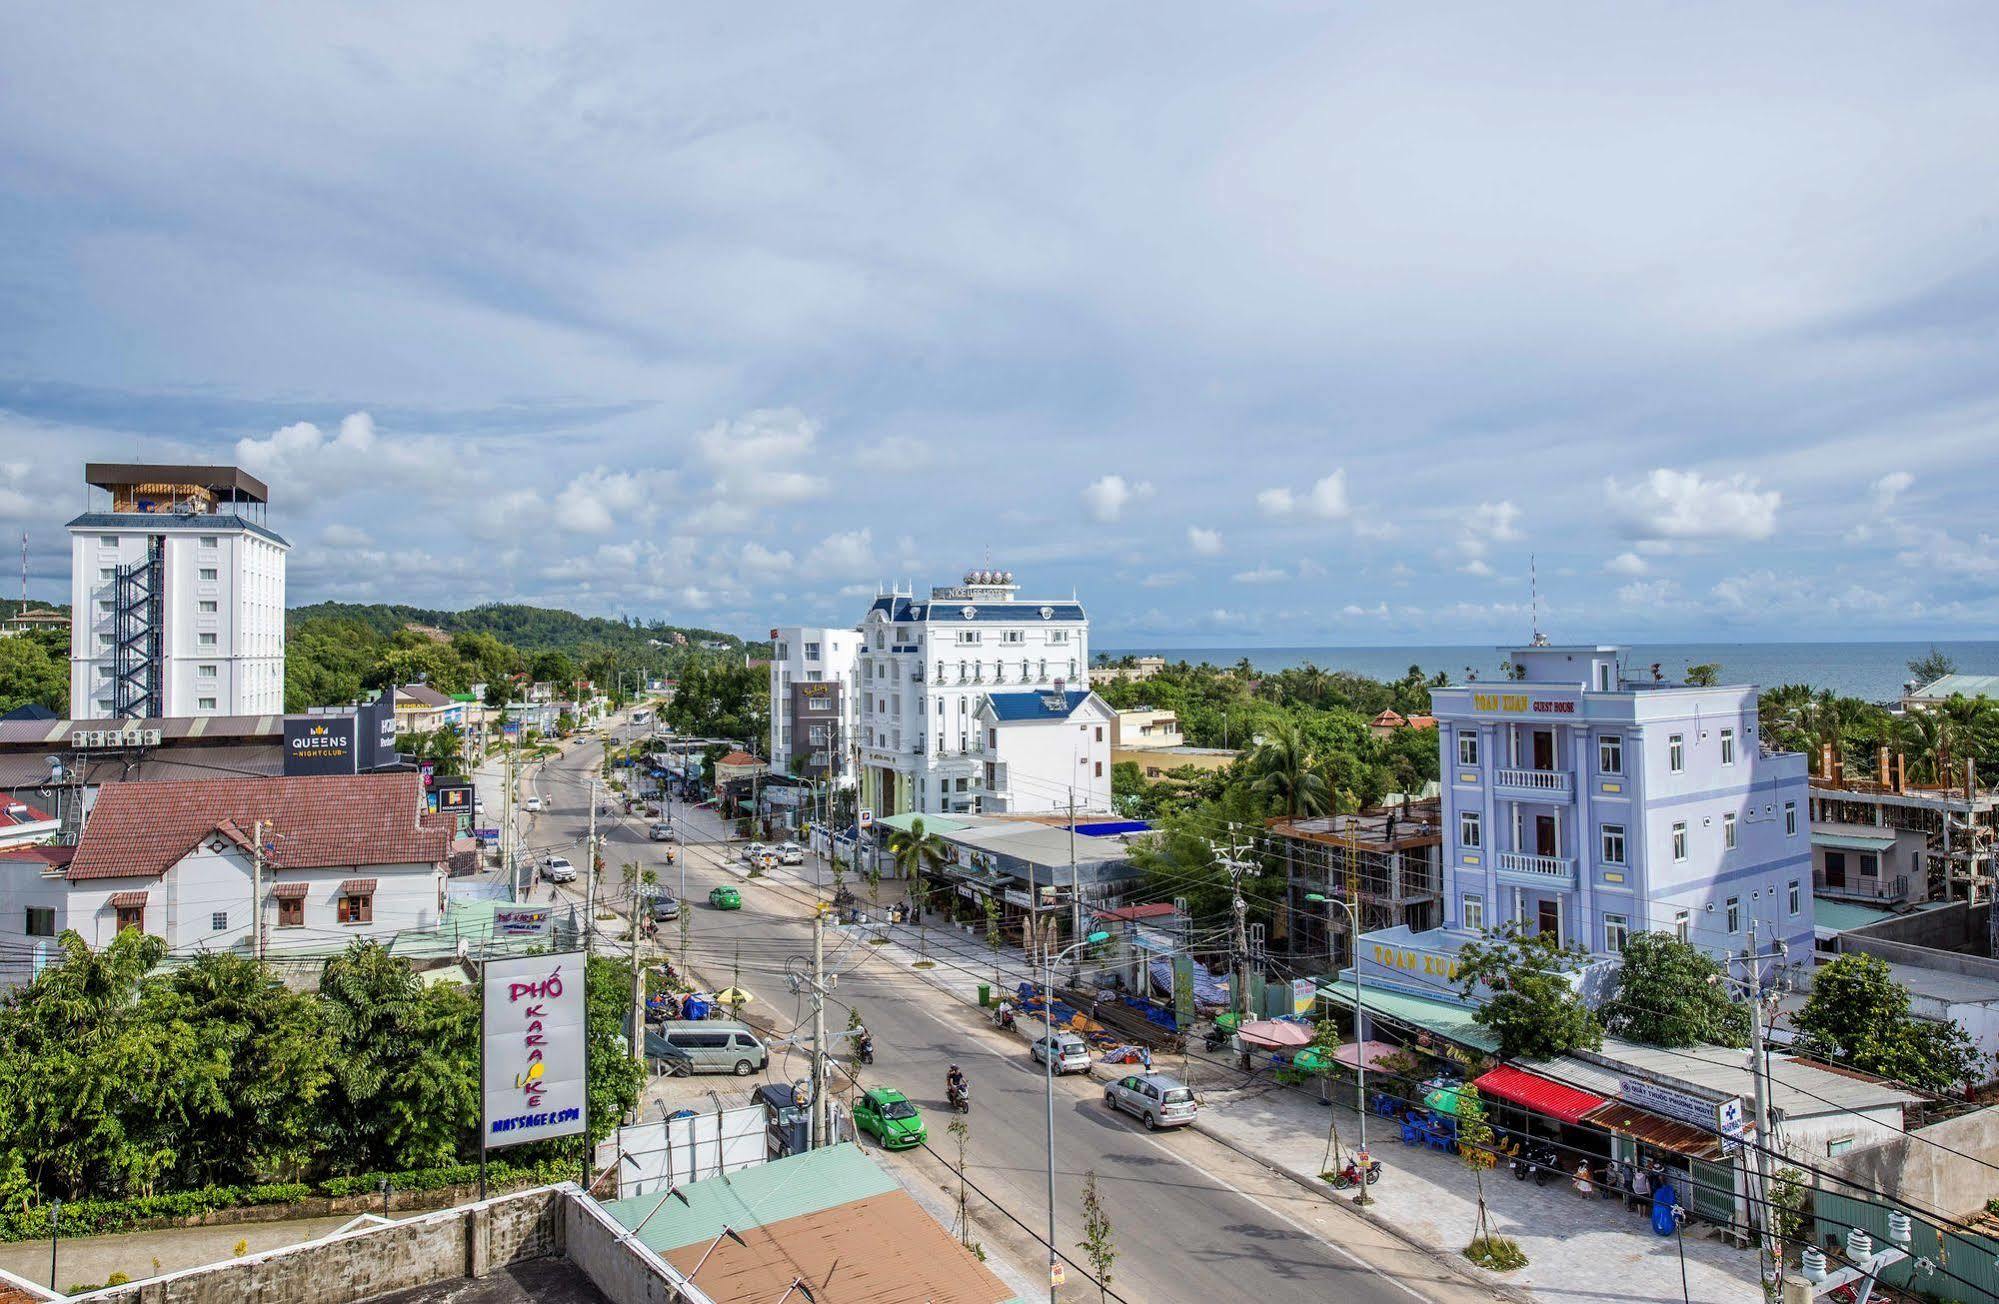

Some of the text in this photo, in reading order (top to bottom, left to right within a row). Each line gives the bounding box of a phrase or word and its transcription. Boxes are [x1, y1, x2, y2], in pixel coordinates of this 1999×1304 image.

[1533, 701, 1553, 712] GUEST
[1554, 701, 1575, 713] HOUSE
[292, 737, 347, 749] QUEENS
[298, 749, 342, 757] NIGHTCLUB
[517, 1004, 548, 1107] KARAOKE
[492, 1113, 548, 1134] MASSAGE
[557, 1107, 580, 1124] SPA
